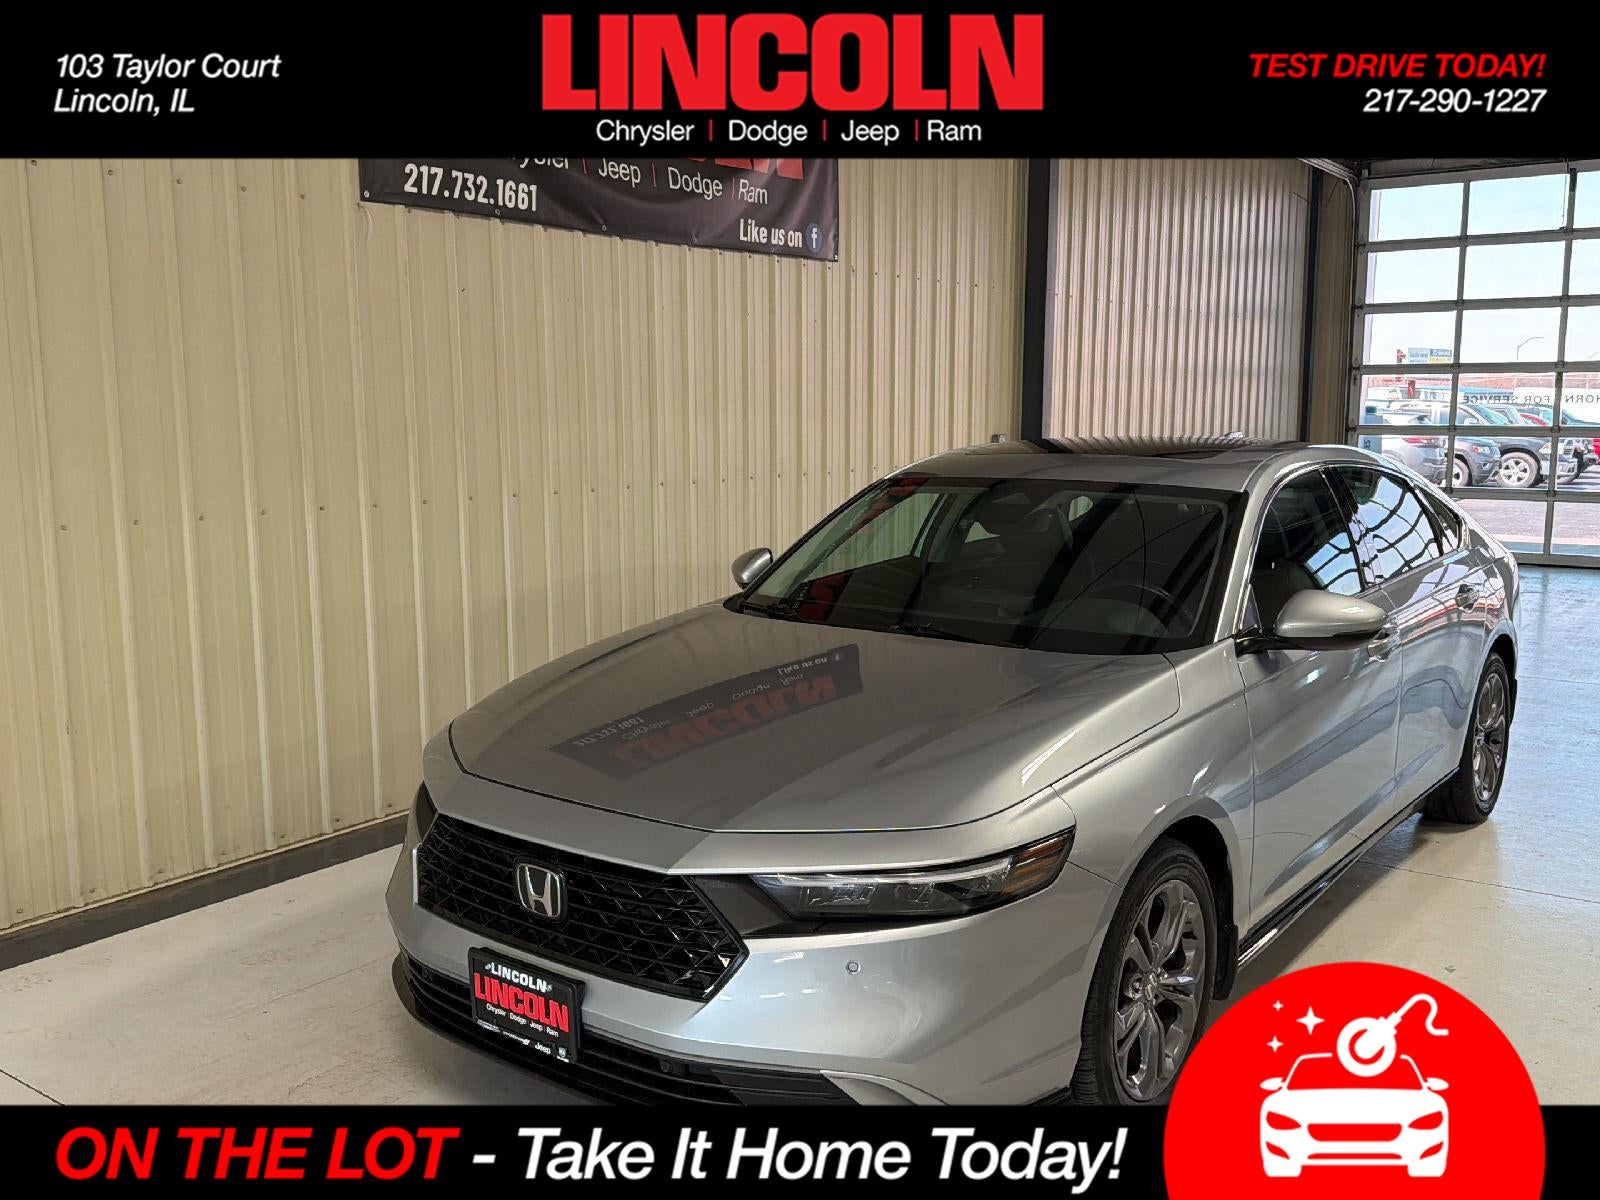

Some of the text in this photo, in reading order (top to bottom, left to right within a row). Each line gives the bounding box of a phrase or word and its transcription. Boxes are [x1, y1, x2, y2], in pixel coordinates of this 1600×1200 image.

[404, 163, 538, 213] 217.732.1661
[598, 158, 641, 185] Jeep
[668, 166, 722, 199] Dodge
[738, 178, 768, 205] Ram
[739, 218, 768, 244] Like
[770, 224, 786, 246] us
[787, 229, 803, 248] on
[491, 962, 546, 993] LINCOLN
[474, 972, 570, 1033] LINCOLN
[509, 1012, 527, 1025] Dodge
[529, 1020, 544, 1032] Jeep
[546, 1026, 559, 1037] Ram
[534, 1042, 551, 1055] Jeep
